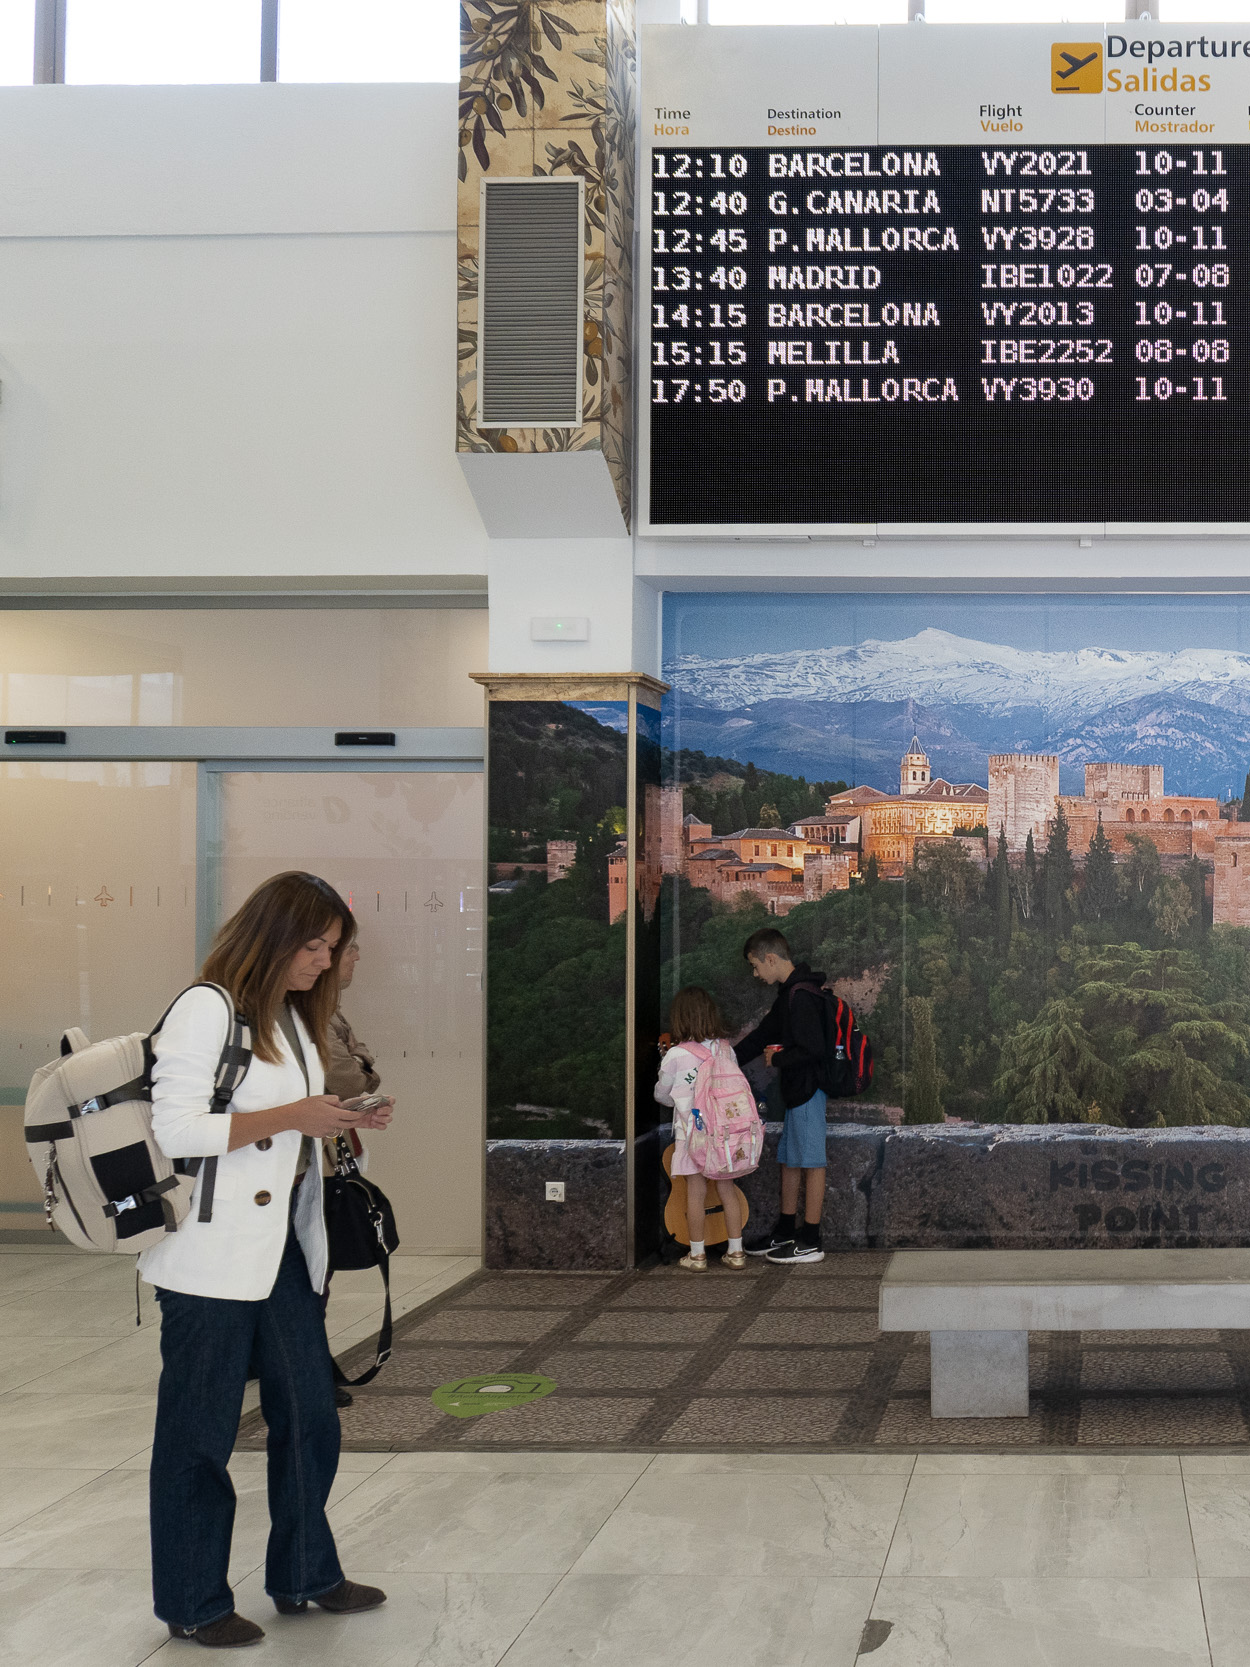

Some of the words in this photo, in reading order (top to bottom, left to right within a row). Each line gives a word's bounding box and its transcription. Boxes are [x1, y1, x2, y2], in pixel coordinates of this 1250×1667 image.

[1108, 67, 1210, 92] Salidas
[655, 107, 690, 119] Time
[768, 108, 841, 119] Destination
[980, 105, 1022, 119] Flight
[1135, 104, 1195, 115] Counter
[655, 124, 689, 135] Hora
[768, 125, 816, 136] Destino
[981, 118, 1023, 132] Vuelo
[1136, 120, 1215, 132] Mostrador
[654, 154, 746, 177] 12:10
[769, 152, 940, 177] BARCELONA
[982, 151, 1091, 175] VY2021
[1136, 151, 1226, 174] 10-11
[654, 191, 746, 215] 12:40
[769, 190, 940, 214] G.CANARIA
[982, 189, 1094, 212] NT5733
[1136, 189, 1228, 212] 03-04
[654, 229, 746, 252] 12:45
[769, 227, 958, 252] P.MALLORCA
[982, 227, 1093, 250] VY3928
[1136, 226, 1226, 249] 10-11
[654, 267, 746, 289] 13:40
[769, 266, 880, 289] MADRID
[982, 264, 1112, 288] IBE1022
[1136, 264, 1229, 287] 07-08
[654, 304, 746, 327] 14:15
[769, 303, 939, 327] BARCELONA
[982, 302, 1093, 325] VY2013
[1136, 302, 1226, 325] 10-11
[654, 342, 746, 364] 15:15
[769, 341, 899, 364] MELILLA
[982, 340, 1112, 363] IBE2252
[1136, 340, 1229, 362] 08-08
[654, 379, 746, 402] 17:50
[768, 378, 958, 402] P.MALLORCA
[982, 378, 1093, 400] VY3930
[1136, 377, 1226, 400] 10-11
[1073, 1202, 1206, 1232] POINT
